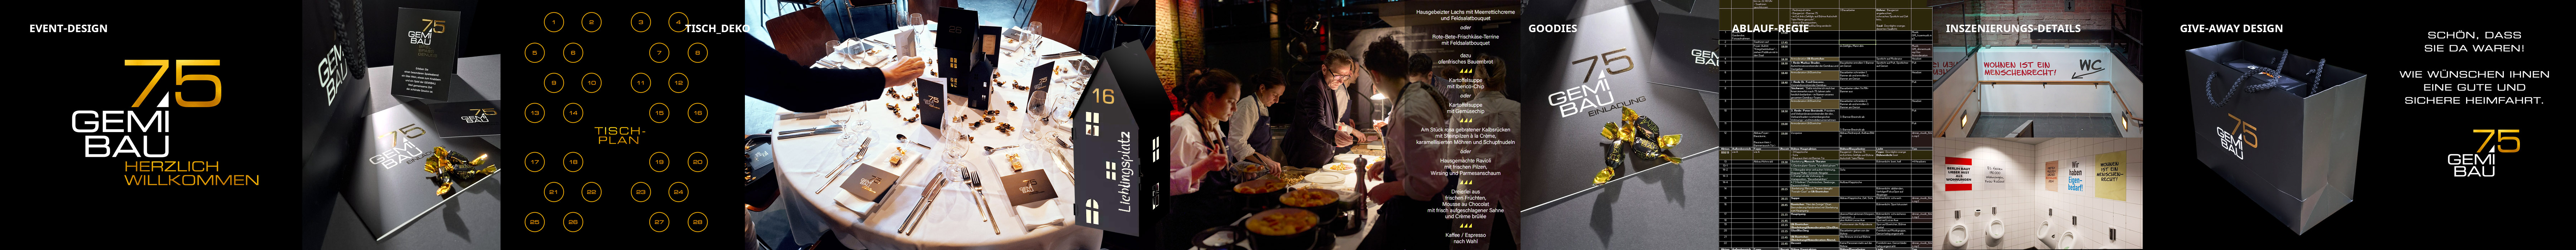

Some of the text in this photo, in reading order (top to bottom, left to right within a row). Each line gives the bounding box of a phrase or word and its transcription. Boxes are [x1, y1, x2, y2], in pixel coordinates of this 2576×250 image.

[422, 19, 445, 33] 75
[2428, 30, 2478, 39] SCHÖN,
[1572, 47, 1634, 84] 75
[2079, 59, 2102, 71] WC
[2428, 70, 2504, 78] WÜNSCHEN
[125, 60, 221, 107] 75
[326, 58, 347, 106] BAU
[1548, 78, 1610, 106] GEMI
[1092, 88, 1114, 104] 16
[1559, 91, 1614, 118] BAU
[1588, 96, 1646, 117] EINLADUNG
[72, 110, 169, 132] GEMI
[2228, 113, 2258, 148] 75
[86, 136, 169, 157] BAU
[377, 123, 426, 148] 75
[2217, 126, 2243, 151] GEMI
[2473, 130, 2520, 152] 75
[369, 141, 416, 165] GEMI
[381, 147, 423, 169] BAU
[2221, 138, 2243, 160] BAU
[2448, 154, 2494, 165] GEMI
[126, 161, 218, 171] HERZLICH
[1117, 131, 1133, 212] Lieblingsplatz
[2454, 166, 2494, 176] BAU
[125, 175, 259, 185] WILLKOMMEN
[869, 175, 882, 184] 75
[2069, 176, 2082, 185] Eigen-
